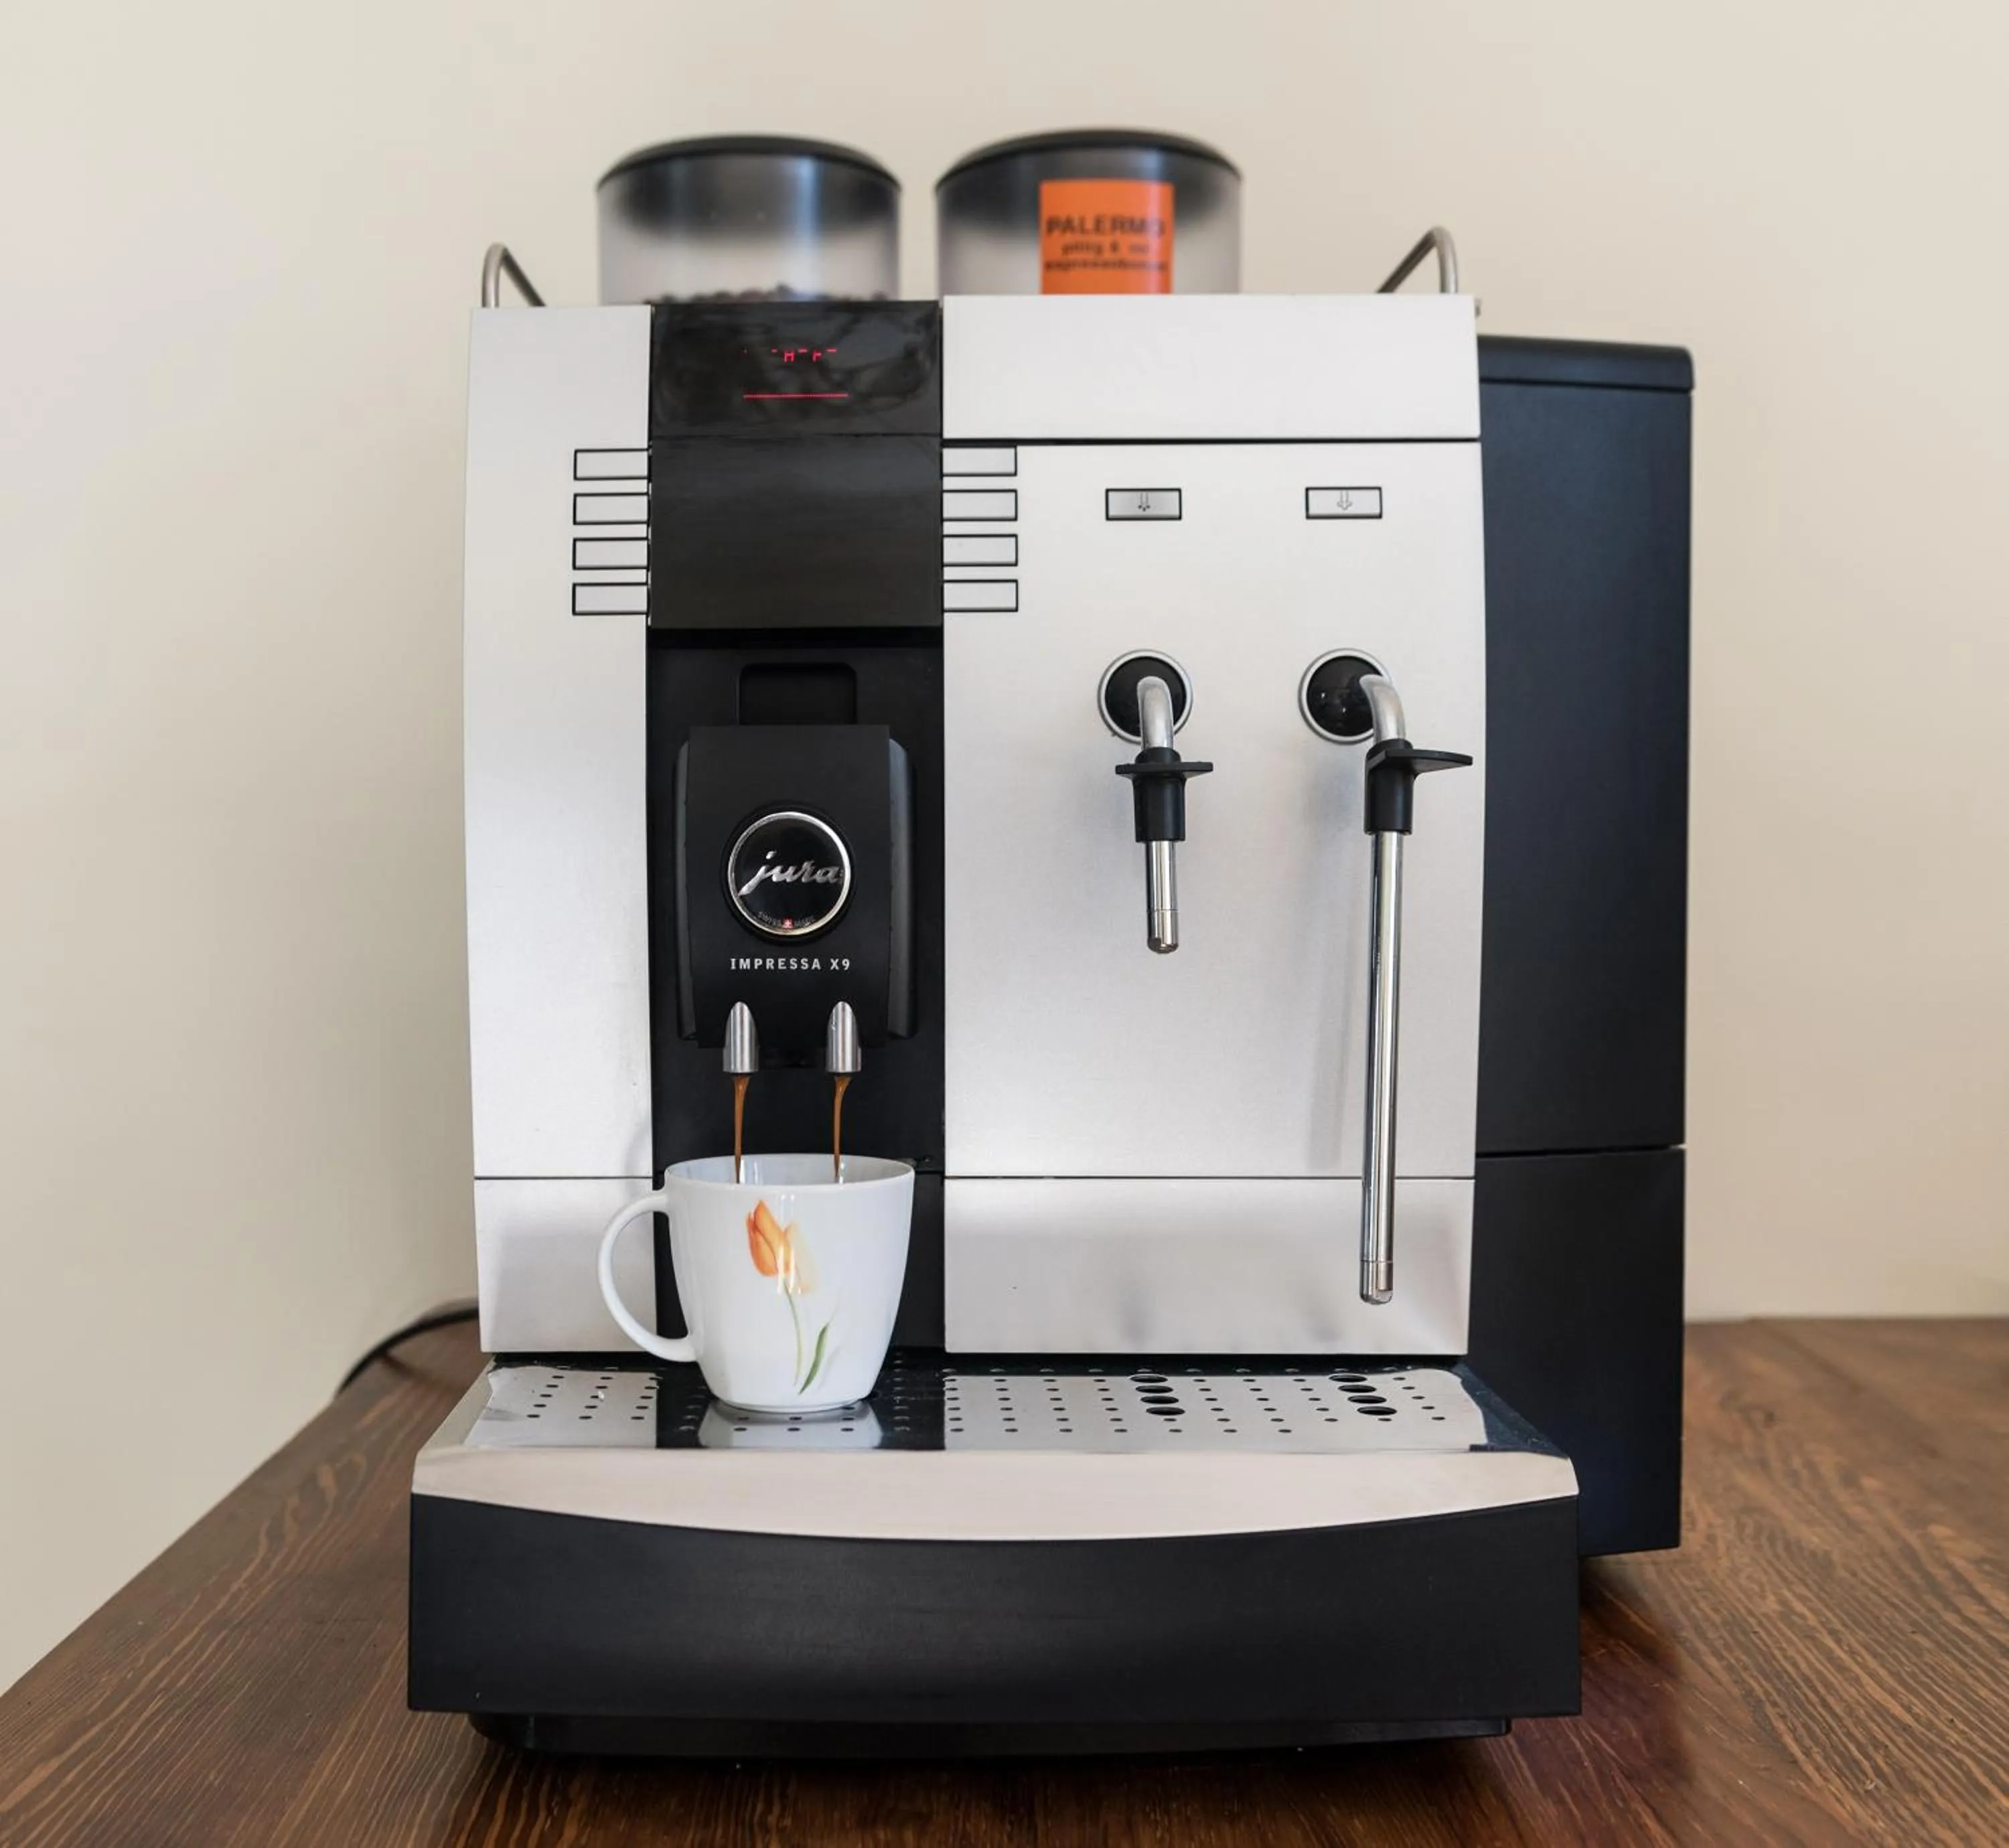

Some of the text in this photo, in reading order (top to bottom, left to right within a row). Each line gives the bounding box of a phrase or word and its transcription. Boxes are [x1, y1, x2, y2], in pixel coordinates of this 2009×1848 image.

[737, 851, 840, 897] jura
[730, 958, 850, 970] IMPRESSA X9
